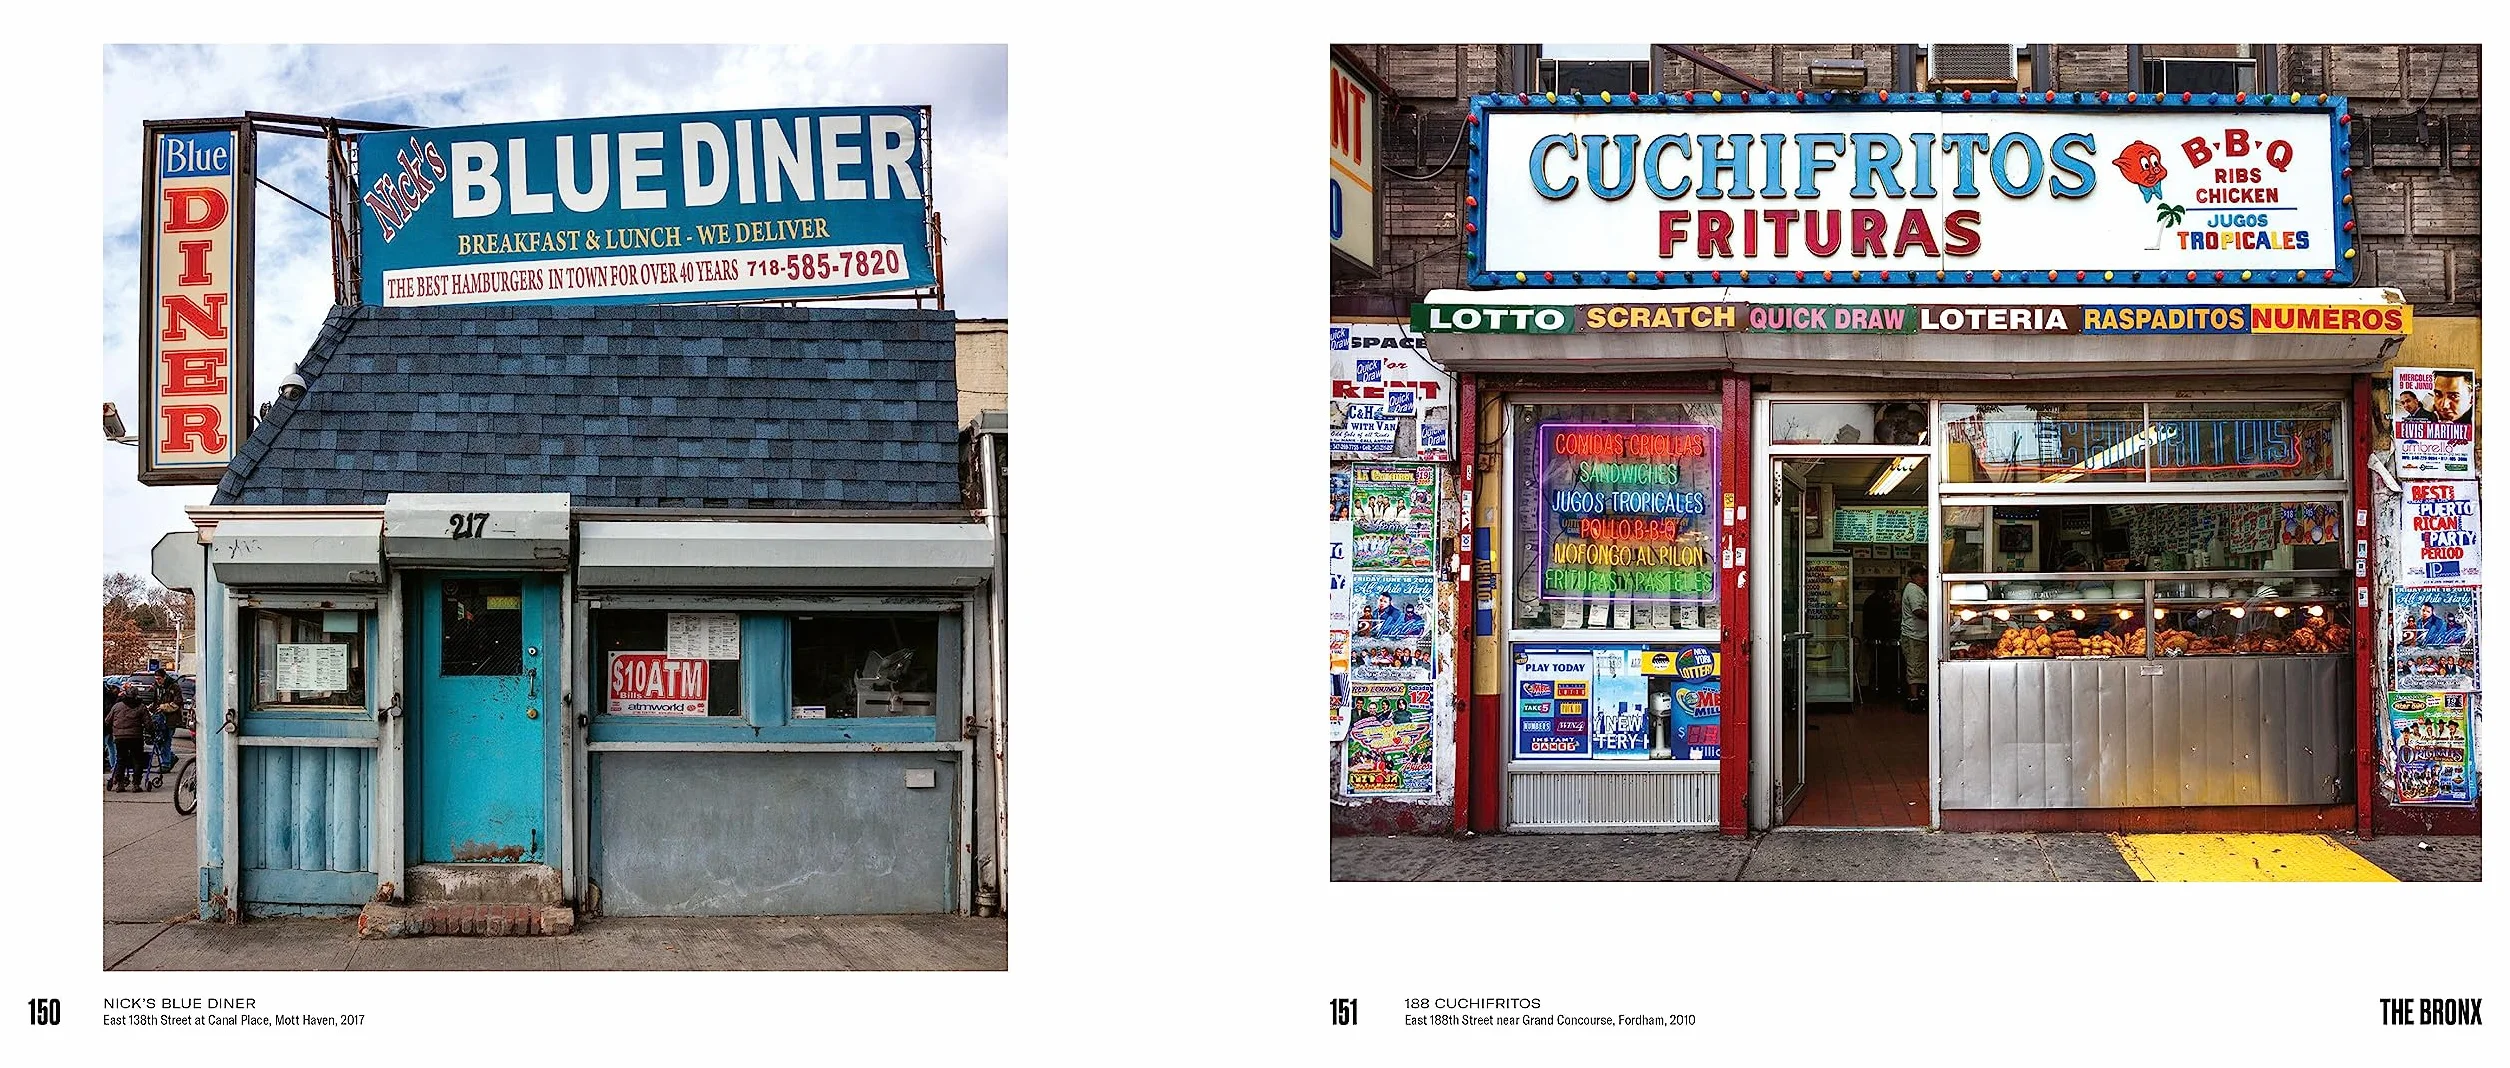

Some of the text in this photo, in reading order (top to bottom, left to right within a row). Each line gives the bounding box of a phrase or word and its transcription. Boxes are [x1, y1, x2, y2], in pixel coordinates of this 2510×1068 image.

[166, 139, 228, 173] Blue
[451, 115, 921, 218] BLUE DINER
[1529, 132, 2097, 200] CUCHIFRITOS
[2215, 168, 2262, 185] RIBS
[363, 136, 446, 243] Nick's
[2196, 188, 2279, 204] CHICKEN
[2207, 213, 2268, 229] JUGOS
[458, 231, 580, 256] BREAKFAST
[585, 230, 600, 250] &
[605, 227, 681, 249] LUNCH
[697, 224, 731, 245] WE
[735, 218, 830, 243] DELIVER
[1658, 209, 1981, 258] FRITURAS
[2177, 230, 2309, 251] TROPICALES
[388, 250, 899, 298] THE BEST HAMBURGERS IN TOWN FOR OVER 40 YEARS 718-585-7820
[161, 186, 229, 455] DINER
[1430, 307, 2402, 330] LOTTO SCRATCH QUICK DRAW LOTERIA RASPADITOS NUMEROS
[1357, 360, 1378, 374] Quick
[2400, 374, 2432, 383] MIERCOLES
[1389, 392, 1410, 407] Quick
[1350, 405, 1374, 419] C&H
[2401, 423, 2468, 440] ELVIS MARTINEZ
[1555, 434, 1704, 456] COMIDAS CRIOLLAS
[1579, 461, 1678, 485] SANDWICHES
[2412, 486, 2449, 501] BEST
[1552, 492, 1704, 514] JUGOS TROPICALES
[2420, 501, 2474, 516] PUERTO
[451, 513, 489, 539] 217
[1581, 519, 1631, 540] POLLO
[1635, 520, 1676, 541] B-B-Q
[2413, 516, 2457, 531] RICAN
[2429, 531, 2476, 547] PARTY
[1553, 544, 1703, 567] MOFONGO AL PILON
[2421, 547, 2464, 560] PERIOD
[1545, 569, 1713, 592] FRITURAS Y PASTELES
[1525, 663, 1585, 672] PLAY TODAY
[1681, 665, 1714, 679] LOTTERY
[613, 659, 704, 699] $10 ATM
[1410, 691, 1430, 704] 12
[628, 703, 684, 711] atmworld
[1606, 716, 1642, 732] NEW
[1532, 743, 1575, 751] GAMES
